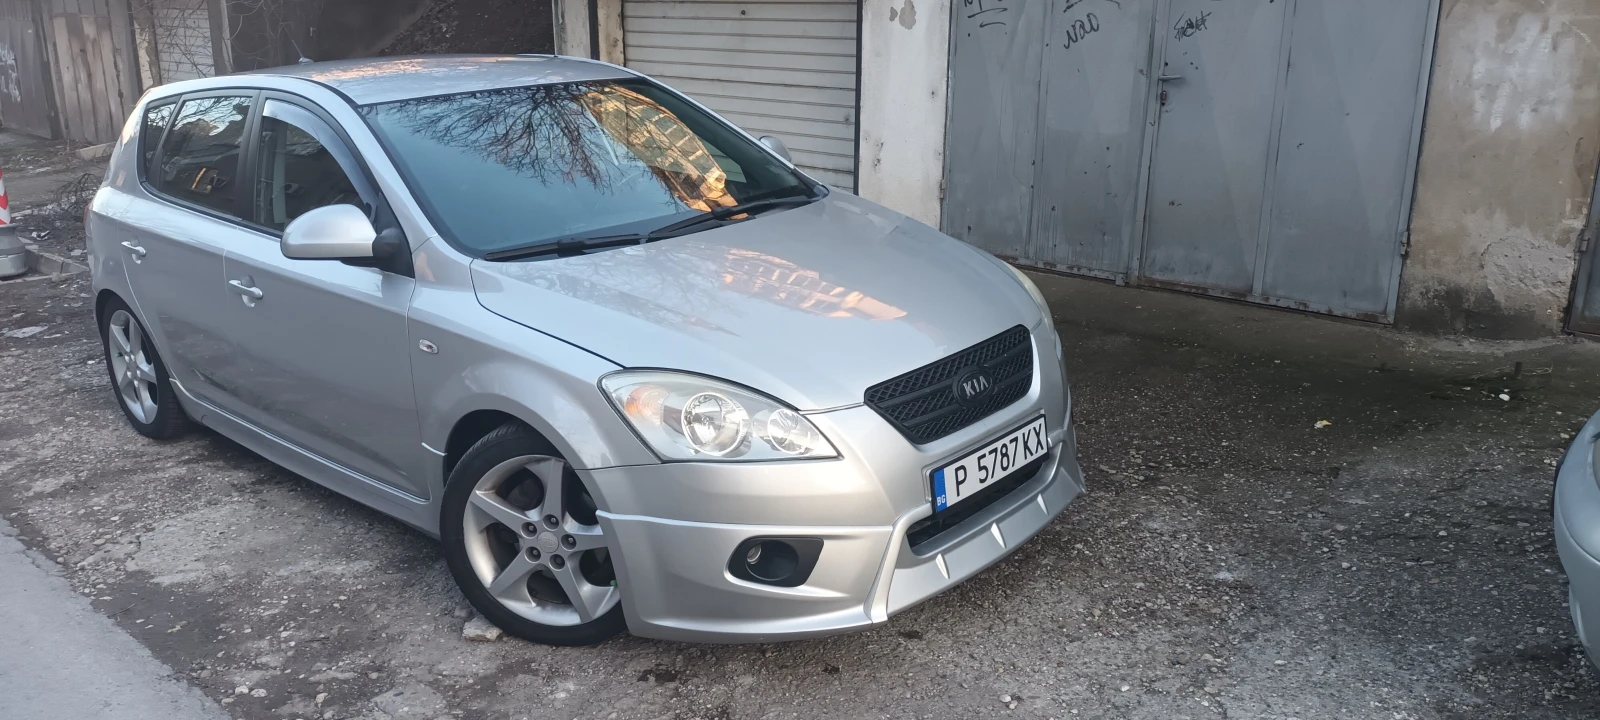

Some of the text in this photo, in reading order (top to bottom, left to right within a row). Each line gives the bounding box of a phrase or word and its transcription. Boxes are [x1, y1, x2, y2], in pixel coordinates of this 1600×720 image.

[963, 375, 989, 397] KIA
[954, 423, 1045, 497] P 5787 KX
[936, 494, 946, 507] BG
